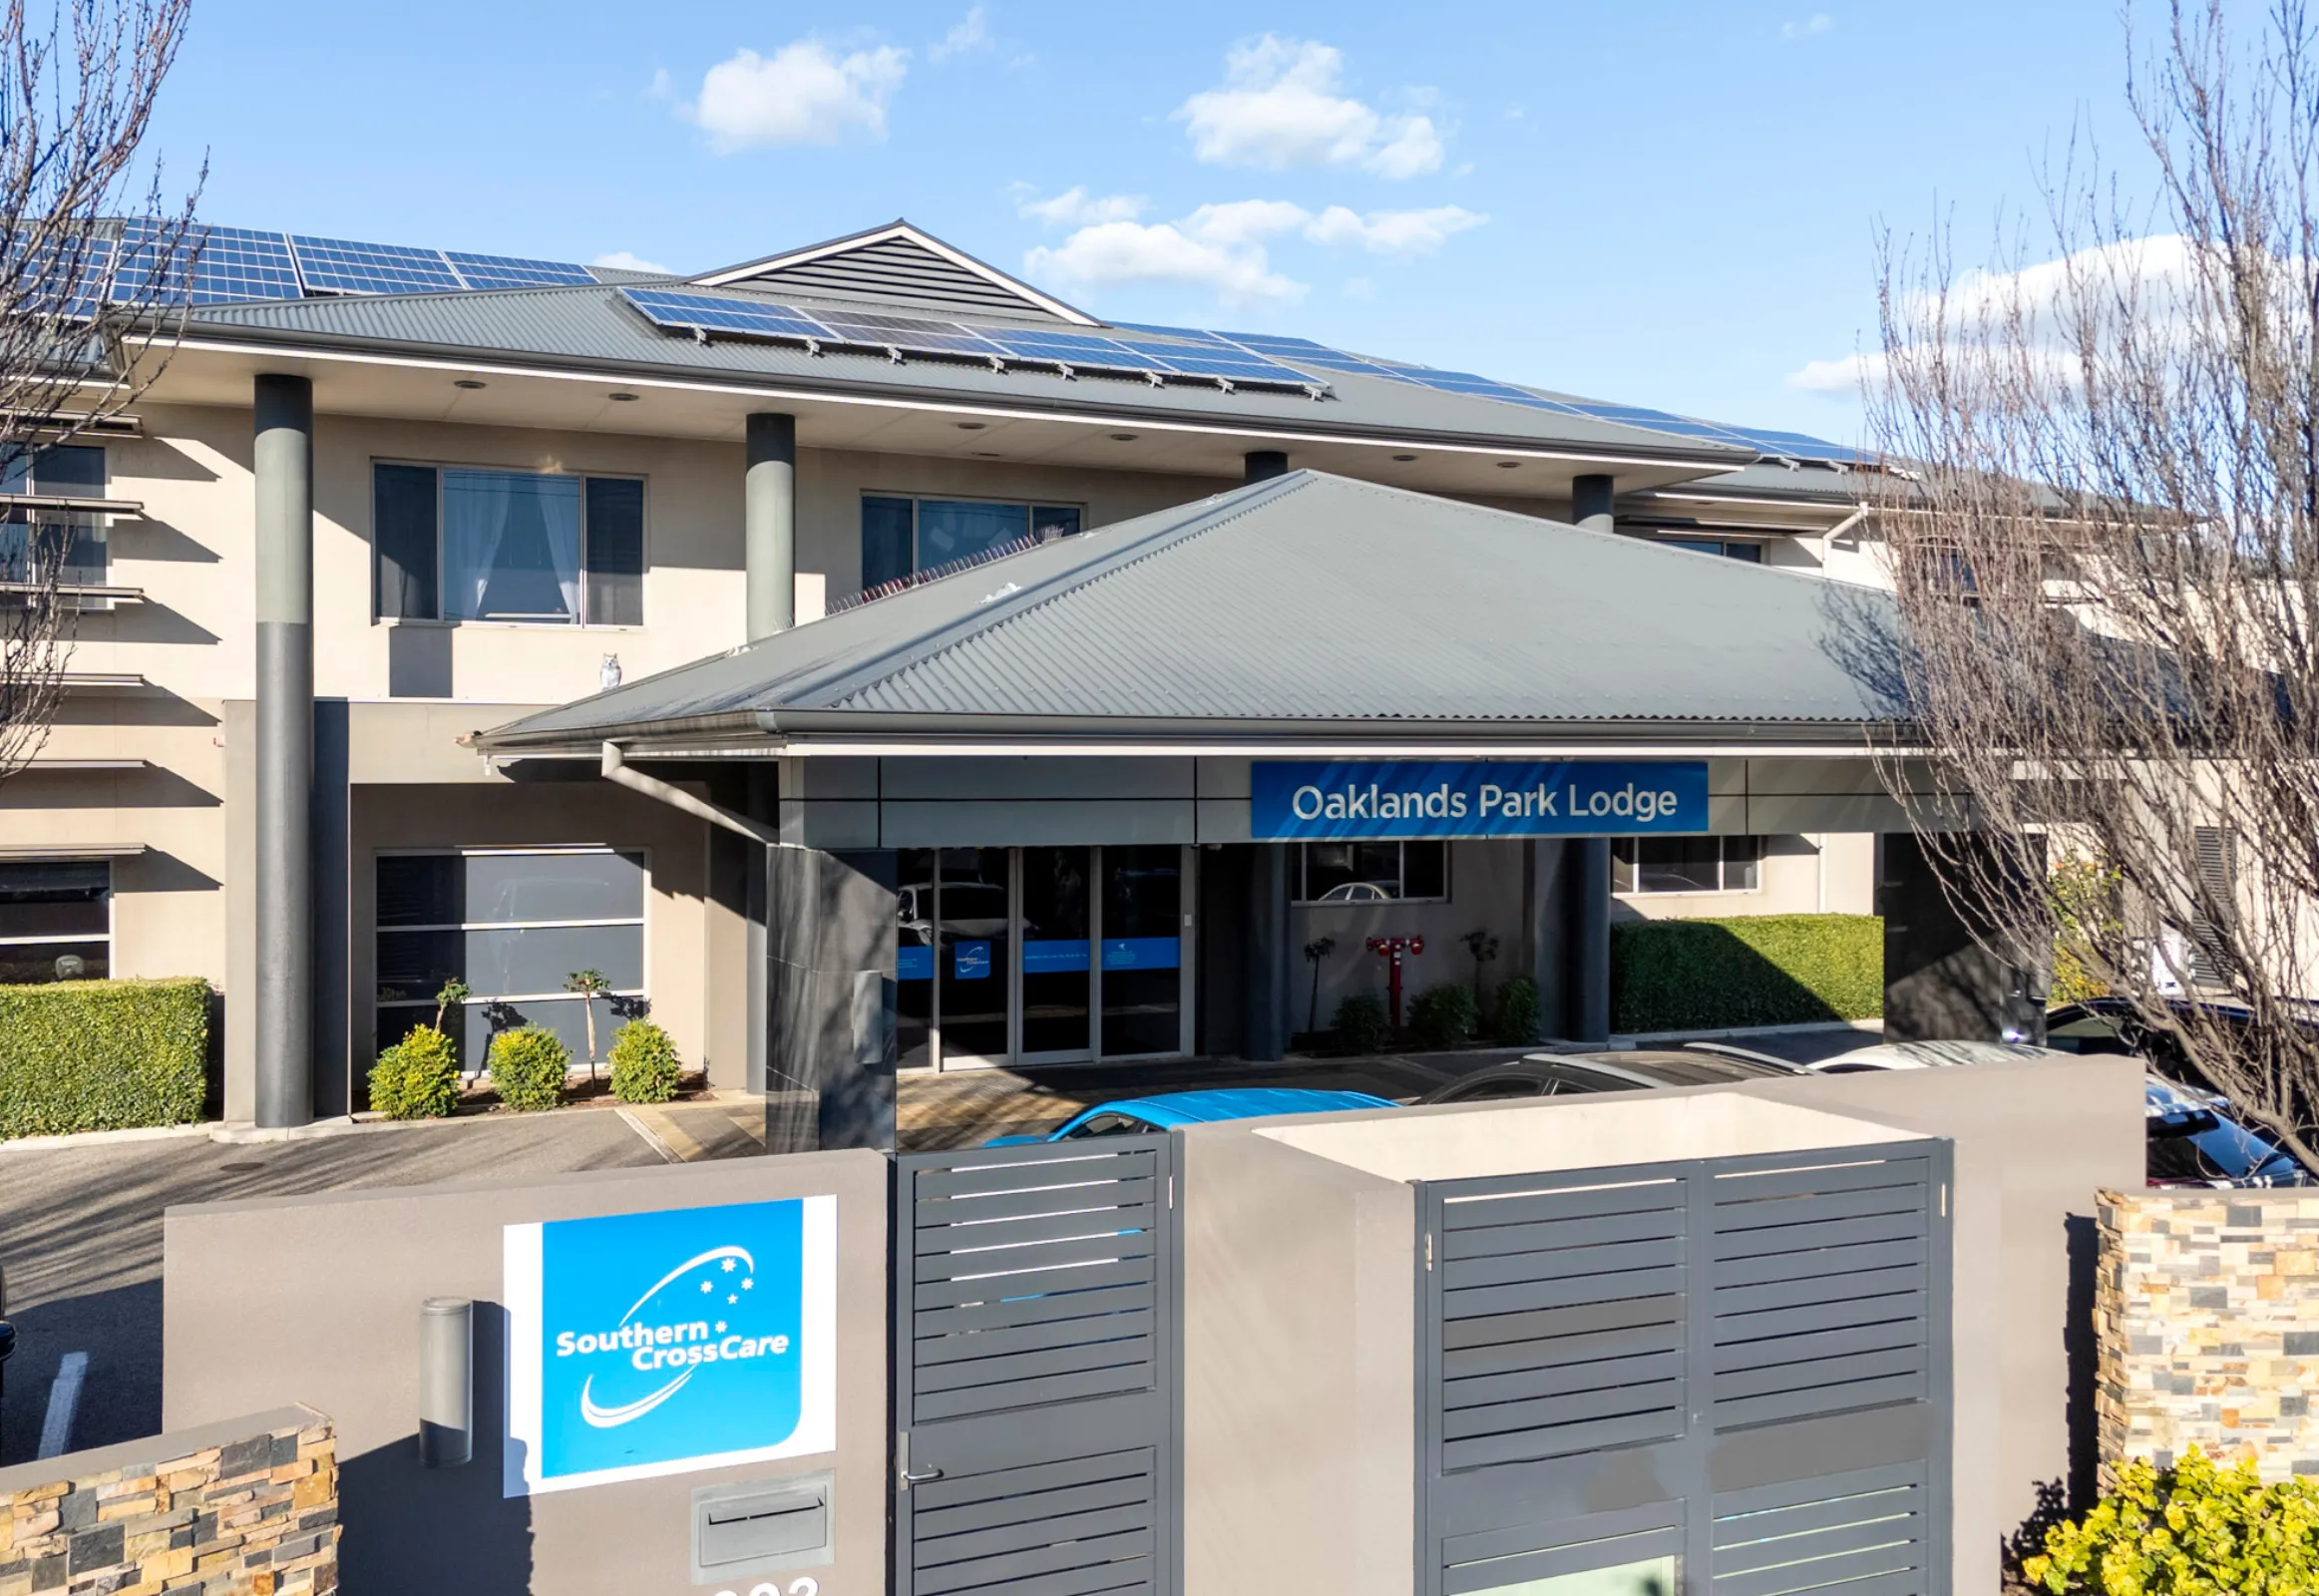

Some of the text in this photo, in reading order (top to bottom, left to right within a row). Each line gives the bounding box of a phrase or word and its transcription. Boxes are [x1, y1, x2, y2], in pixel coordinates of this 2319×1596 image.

[1293, 783, 1678, 822] Oaklands Park Lodge
[556, 1321, 709, 1358] Southern
